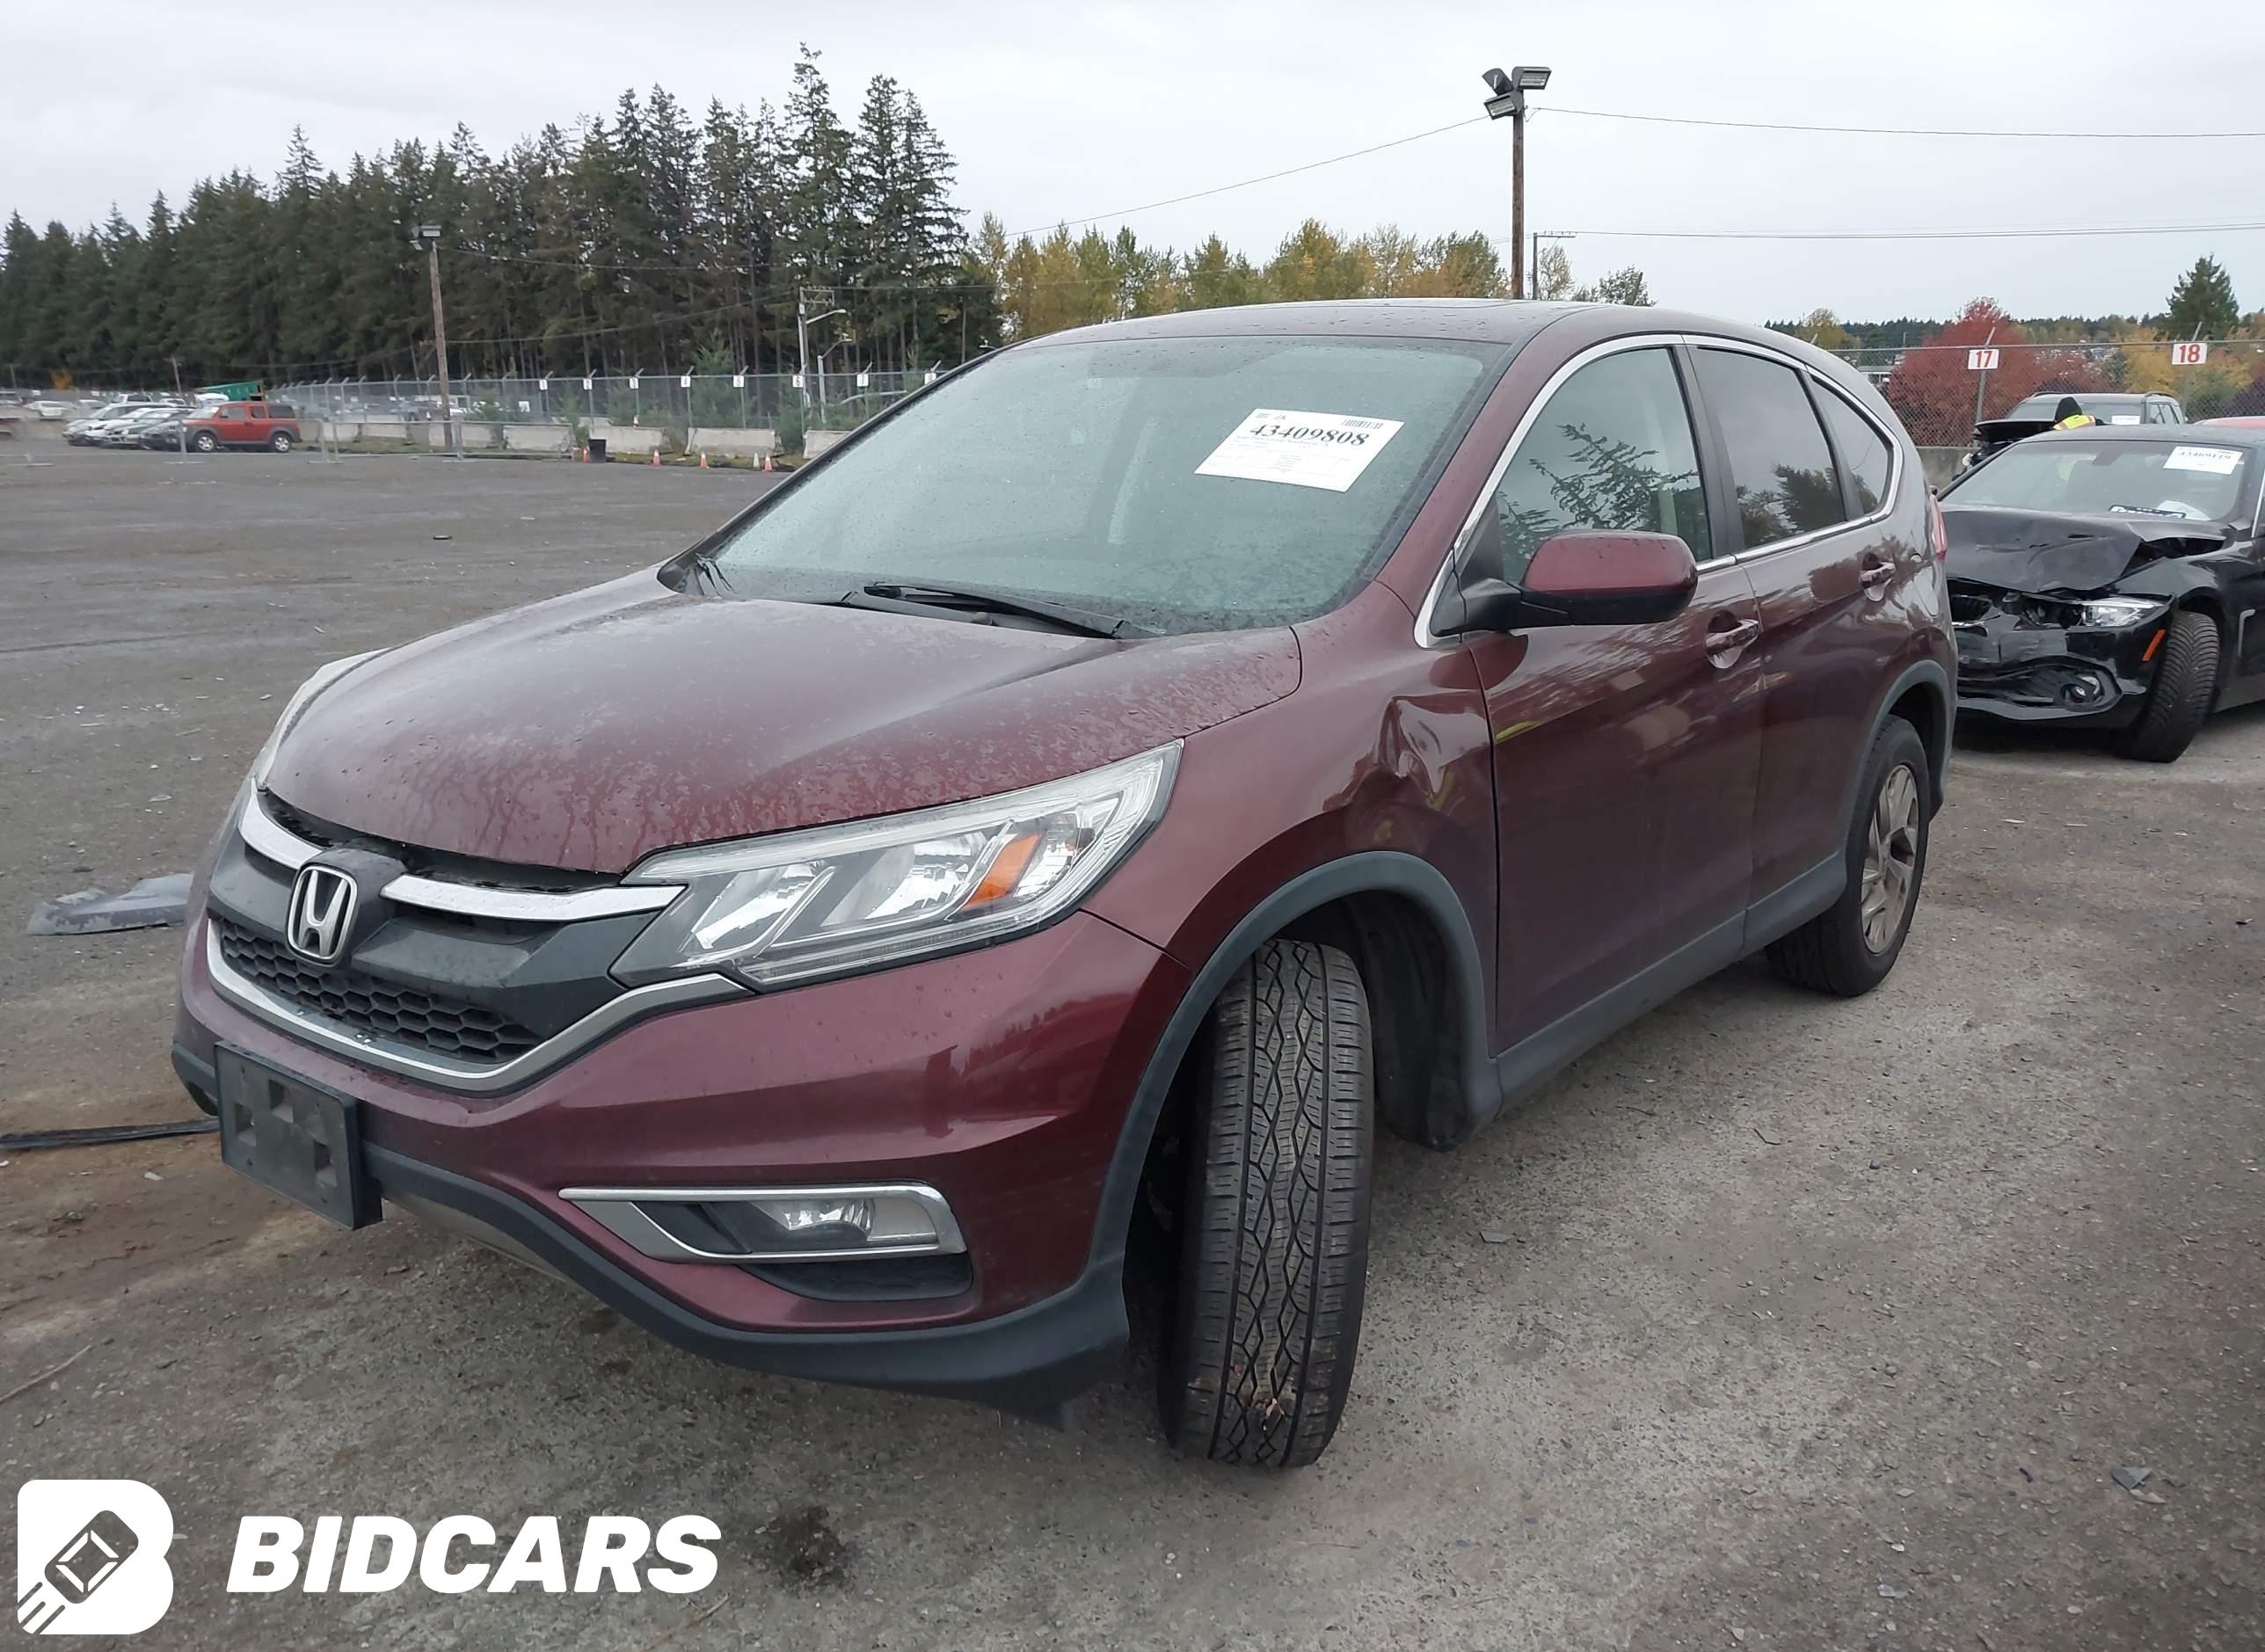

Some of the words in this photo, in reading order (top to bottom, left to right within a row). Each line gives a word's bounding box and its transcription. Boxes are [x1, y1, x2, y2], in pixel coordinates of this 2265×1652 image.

[1975, 350, 1992, 368] 17
[2179, 344, 2200, 363] 18
[1249, 424, 1370, 446] 43409808
